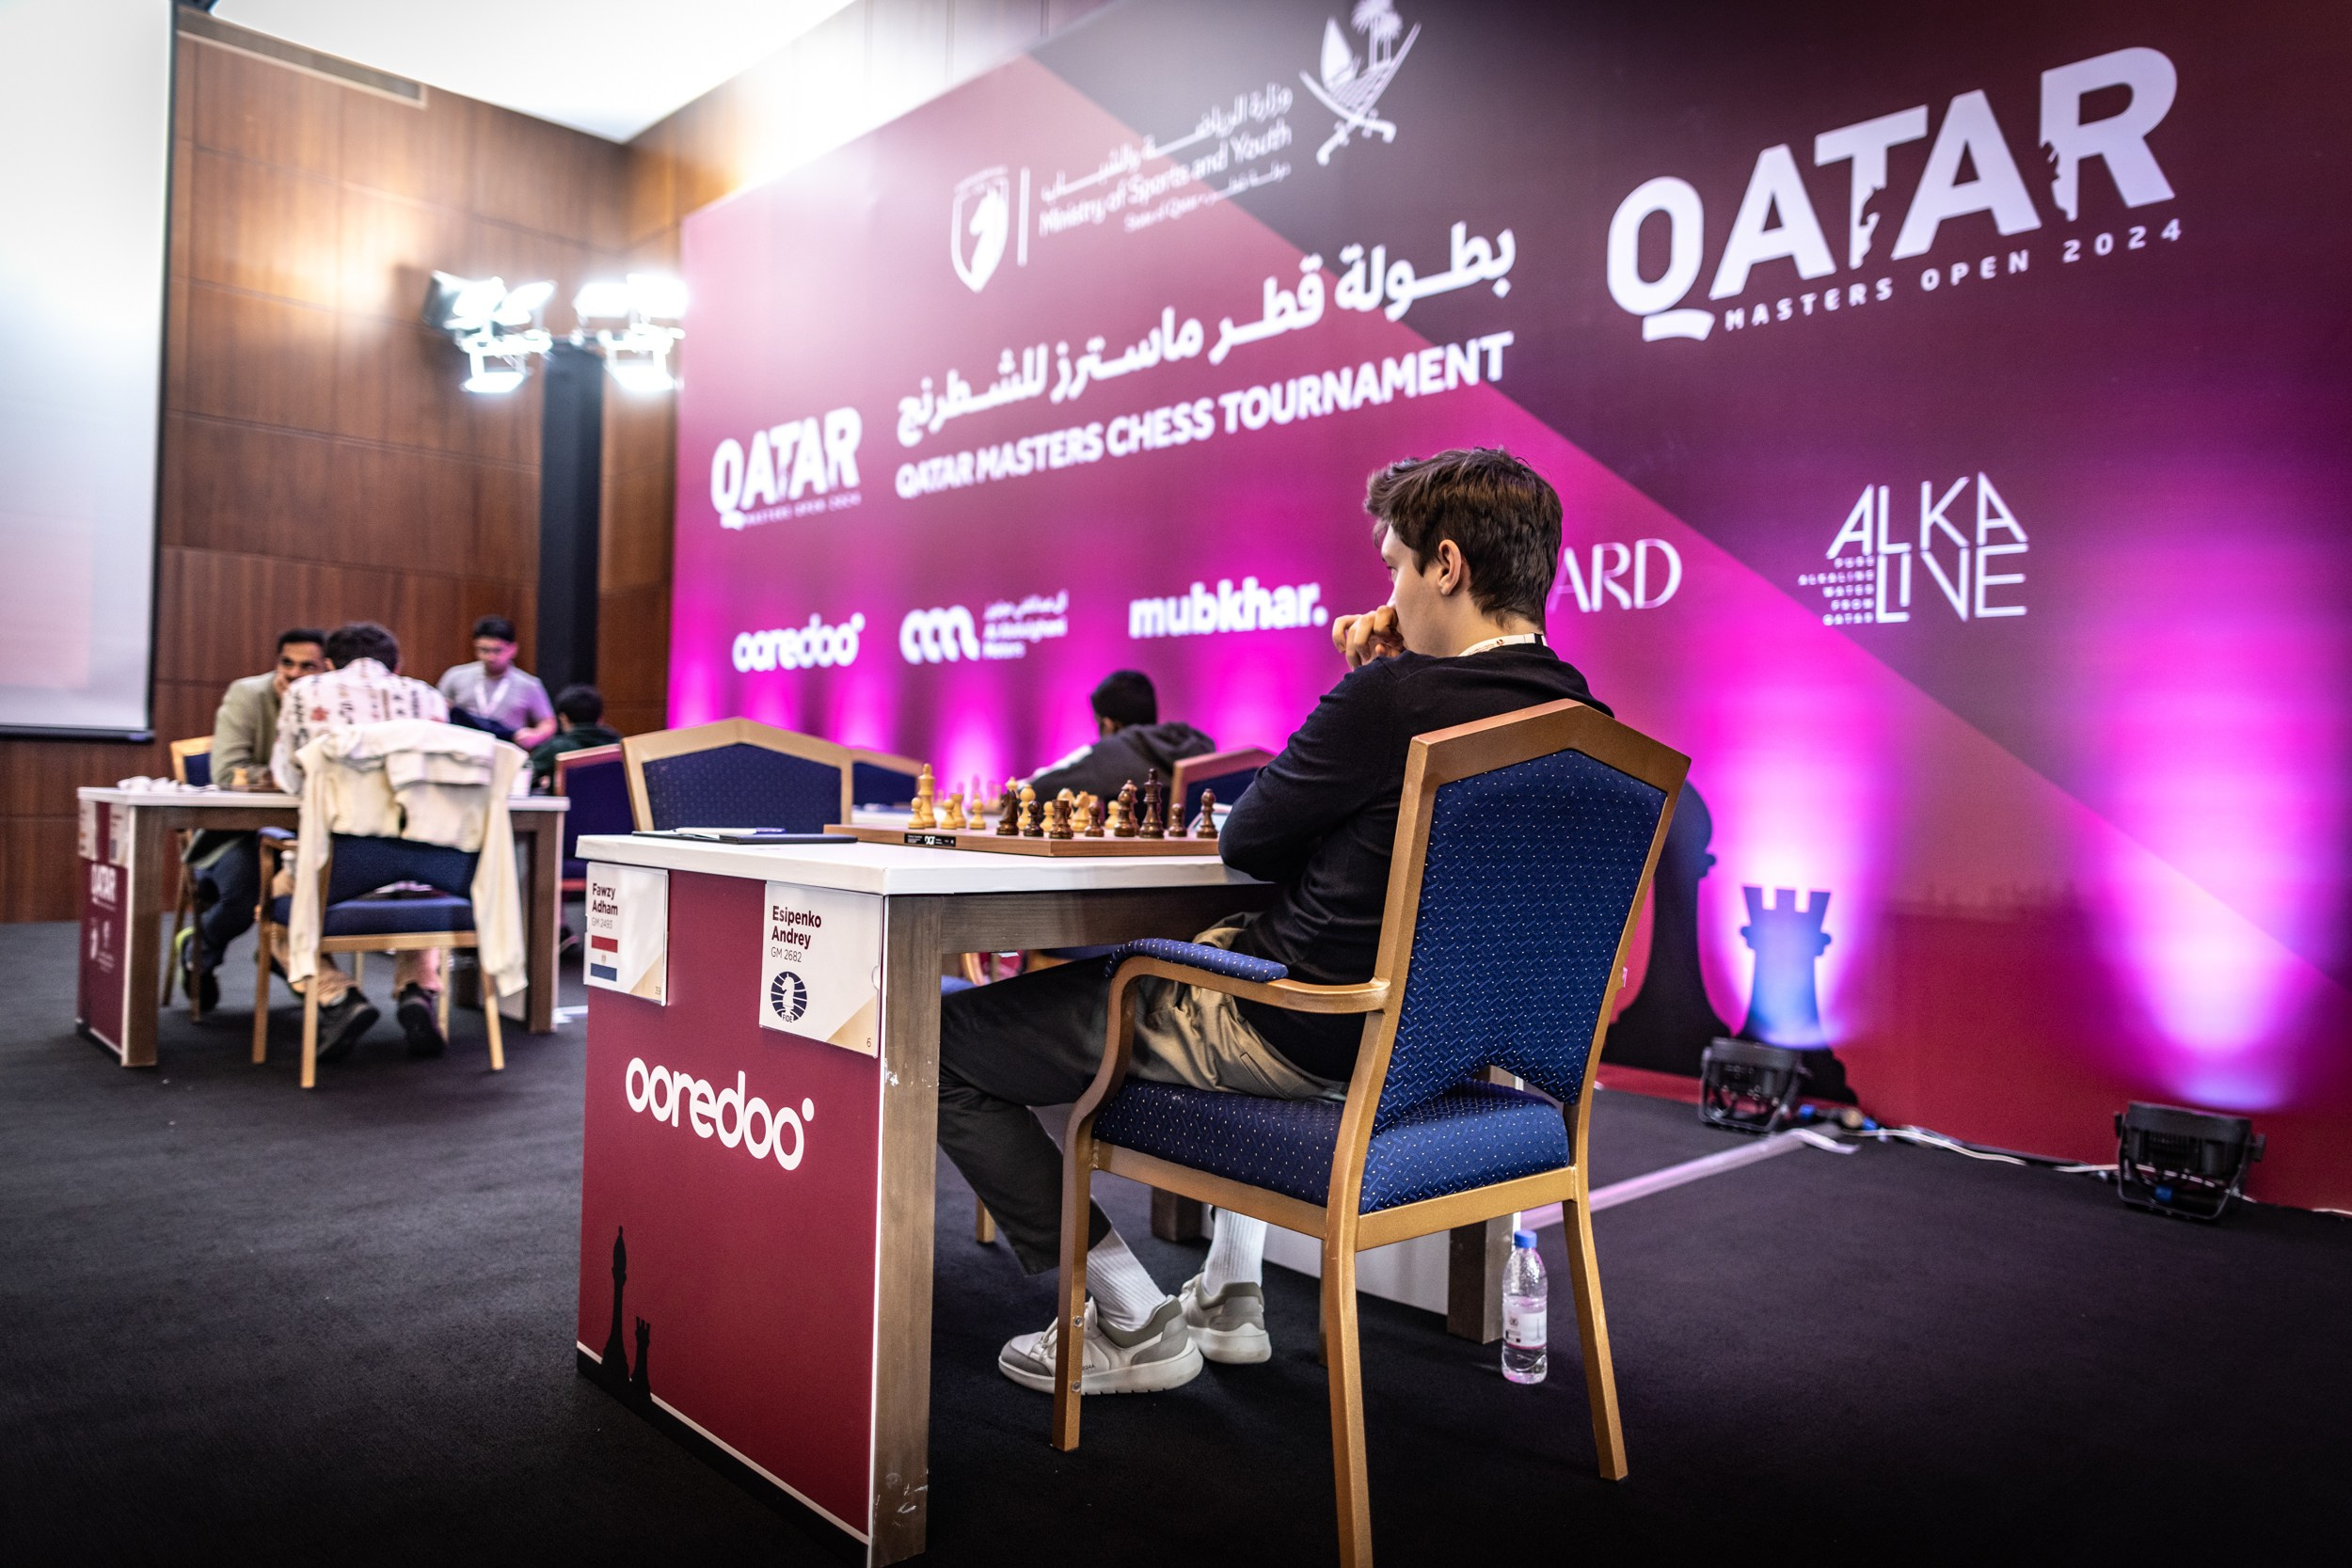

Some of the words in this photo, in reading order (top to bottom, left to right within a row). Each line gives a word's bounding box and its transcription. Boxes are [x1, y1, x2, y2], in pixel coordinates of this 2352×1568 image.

[1039, 195, 1106, 238] Ministry
[1105, 178, 1128, 213] of
[1127, 163, 1190, 205] Sports
[1191, 141, 1229, 180] and
[1230, 117, 1293, 164] Youth
[1606, 46, 2178, 341] QATAR
[1724, 277, 1894, 331] MASTERS
[1919, 249, 2030, 292] OPEN
[2061, 218, 2182, 263] 2024
[896, 451, 975, 499] QATAR
[977, 422, 1104, 483] MASTERS
[1105, 400, 1215, 457] CHESS
[1217, 332, 1514, 434] TOURNAMENT
[710, 406, 863, 530] QATAR
[1546, 537, 1683, 613] ARD
[1128, 576, 1328, 639] mubkhar.
[732, 612, 862, 673] ooredoo
[591, 899, 618, 915] Adham
[592, 882, 616, 900] Fawzy
[772, 905, 822, 927] Esipenko
[771, 926, 811, 949] Andrey
[771, 946, 783, 960] GM
[784, 948, 803, 962] 2682
[782, 1013, 793, 1023] FIDE
[866, 1037, 871, 1048] 6
[626, 1057, 809, 1171] ooredoo
